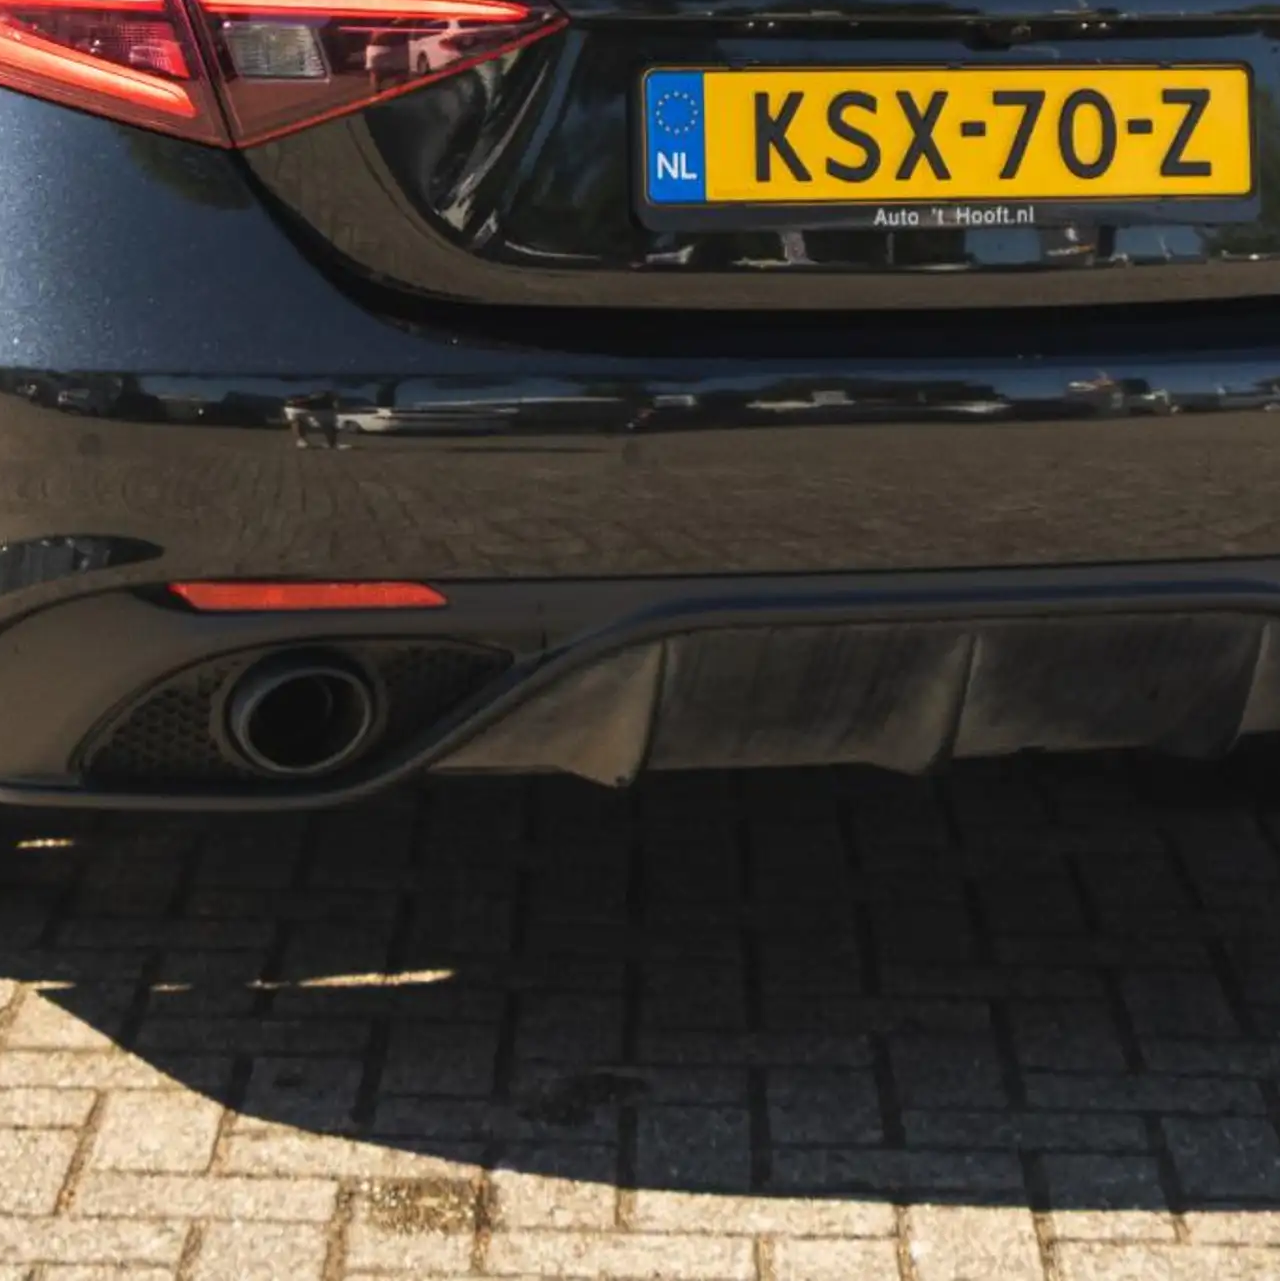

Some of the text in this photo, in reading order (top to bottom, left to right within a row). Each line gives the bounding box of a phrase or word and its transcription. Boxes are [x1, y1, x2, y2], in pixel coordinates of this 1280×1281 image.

[754, 88, 1212, 182] KSX-70-Z
[656, 152, 697, 180] NL
[873, 205, 1034, 226] Auto 't Hooft.nl
